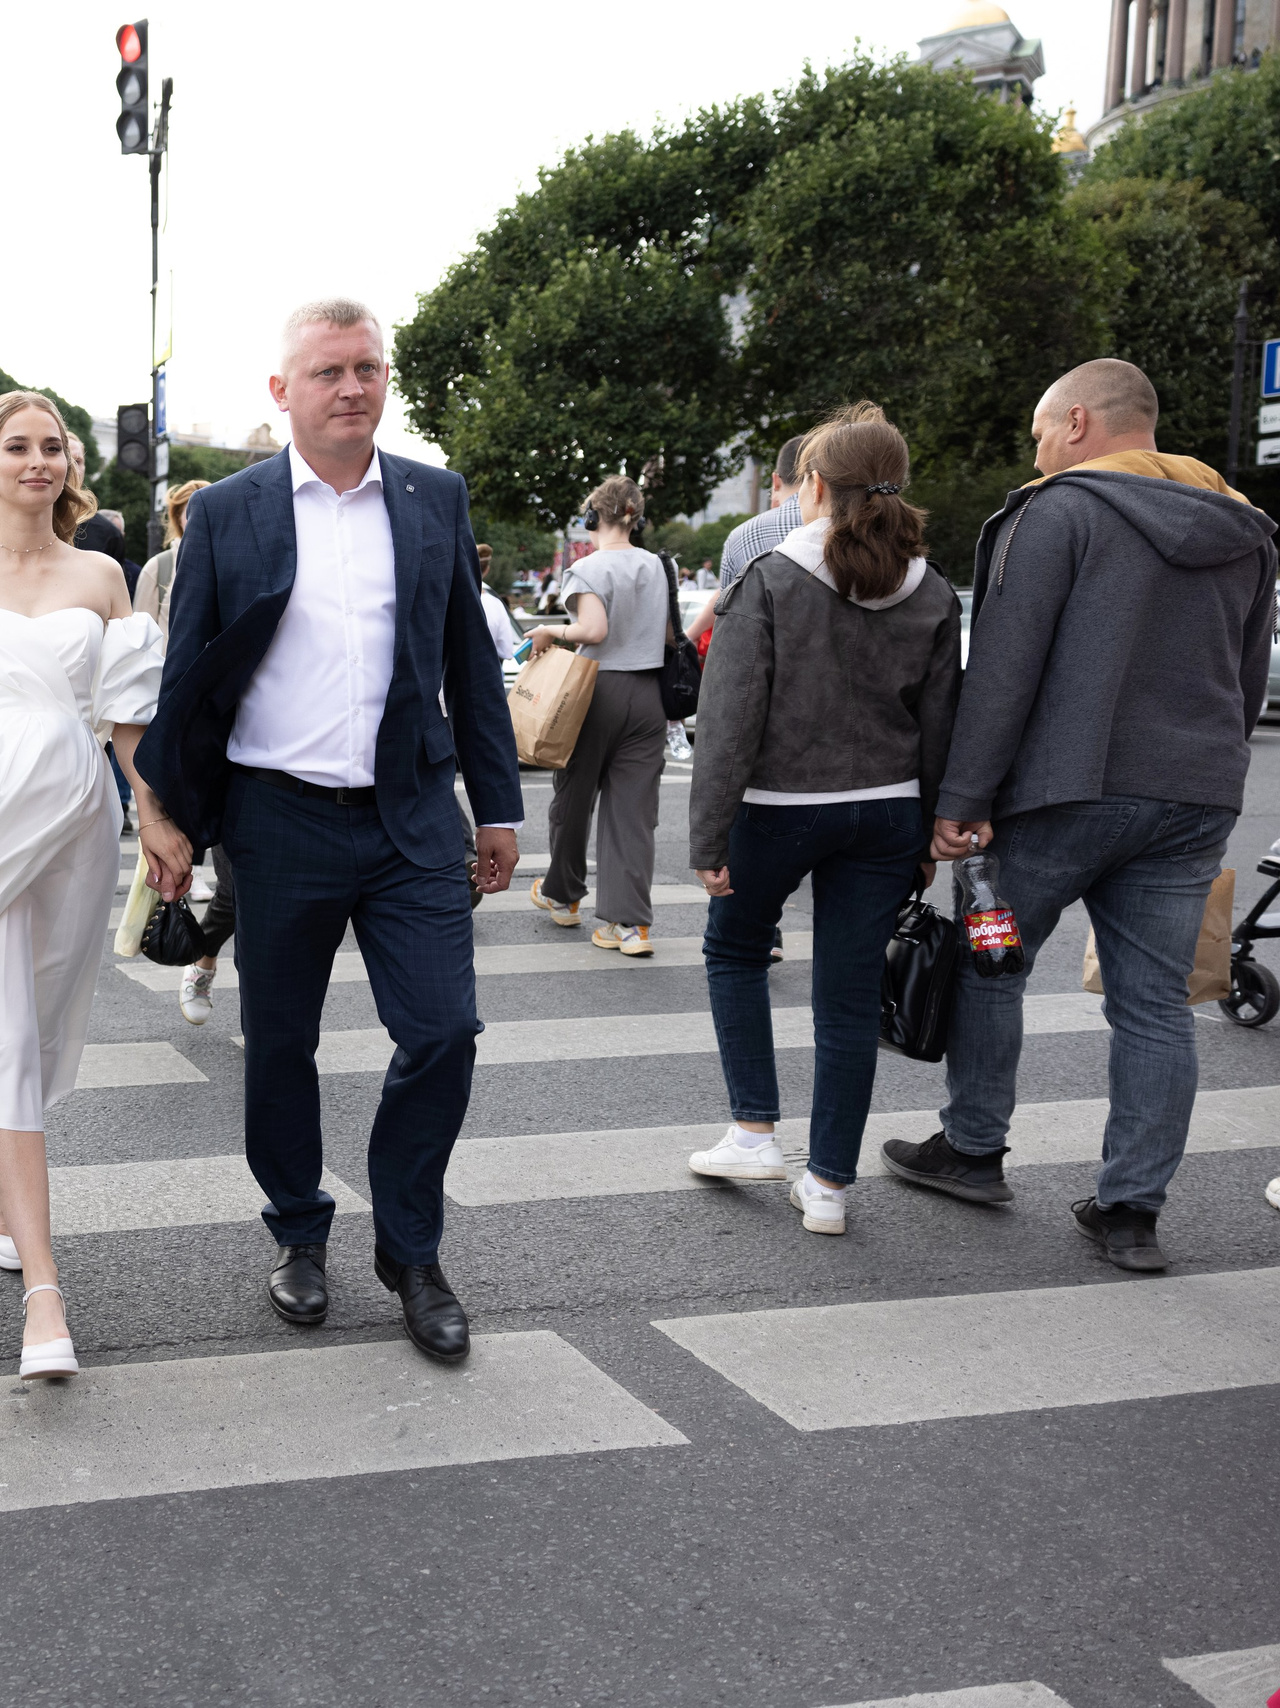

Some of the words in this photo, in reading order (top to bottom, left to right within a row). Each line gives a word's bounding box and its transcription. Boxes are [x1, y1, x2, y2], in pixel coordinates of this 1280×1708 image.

[550, 692, 569, 730] superstep.ru
[968, 920, 1012, 940] Добрый
[982, 936, 1001, 946] cola
